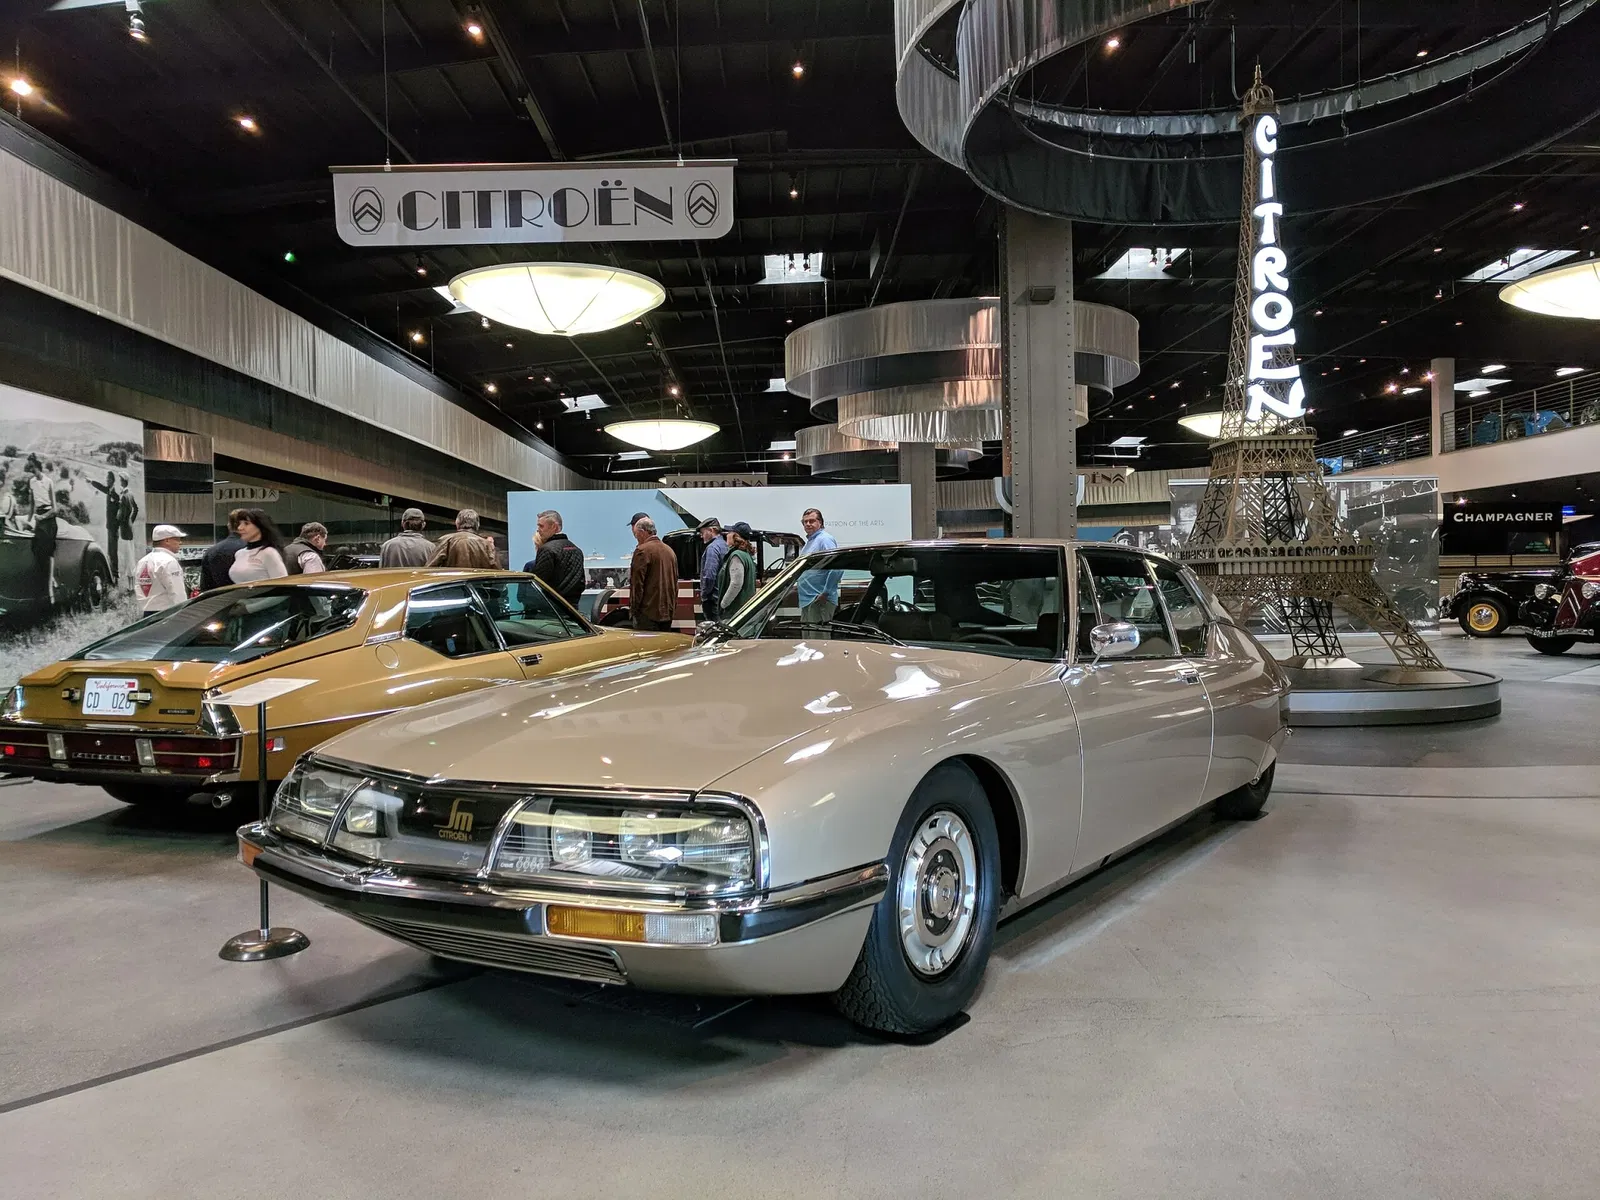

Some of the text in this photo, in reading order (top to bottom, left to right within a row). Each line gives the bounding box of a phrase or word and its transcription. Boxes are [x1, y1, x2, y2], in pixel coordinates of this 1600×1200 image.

[396, 179, 674, 232] CITROËN
[1246, 114, 1307, 423] CITROEN
[858, 519, 869, 527] THE
[869, 519, 885, 527] ARTS
[1453, 512, 1554, 523] CHAMPAGNER
[86, 692, 100, 708] CD
